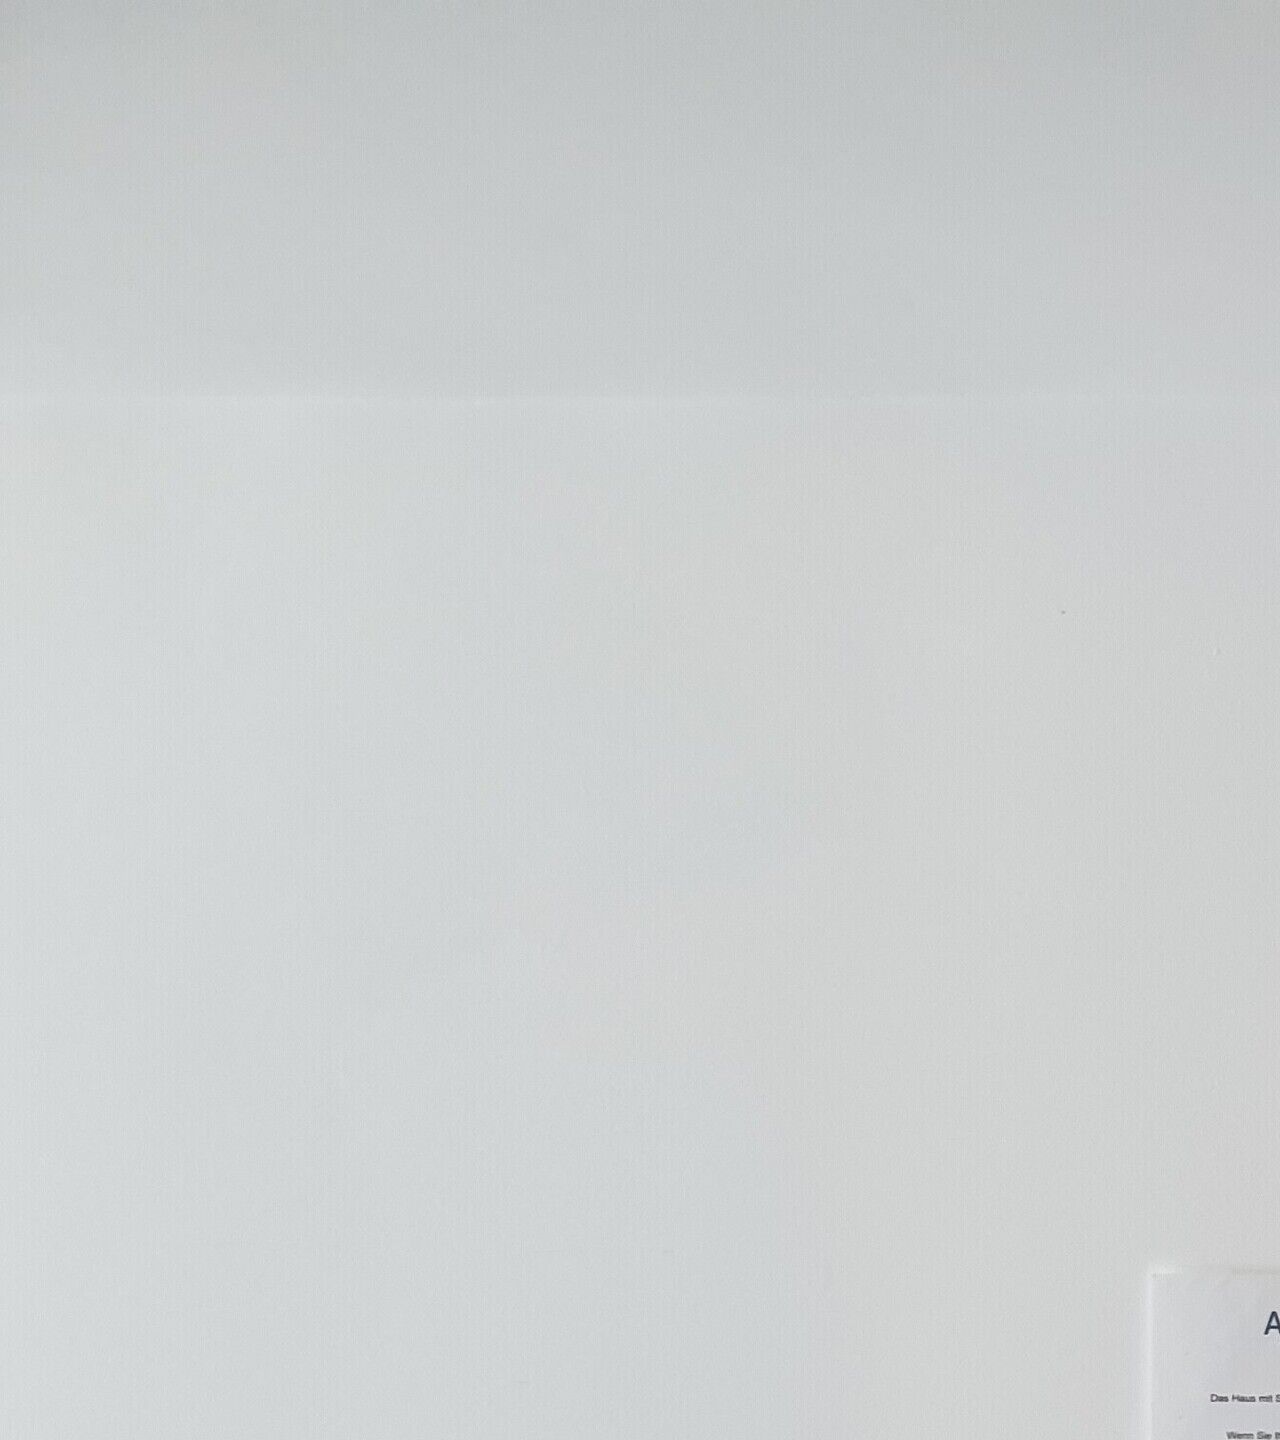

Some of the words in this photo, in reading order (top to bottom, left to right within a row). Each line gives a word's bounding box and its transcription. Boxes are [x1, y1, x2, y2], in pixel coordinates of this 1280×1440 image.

[1210, 1394, 1230, 1403] Das
[1231, 1394, 1256, 1403] Haus
[1259, 1394, 1273, 1403] mit
[1226, 1431, 1255, 1440] Wenn
[1256, 1431, 1273, 1440] Sie
